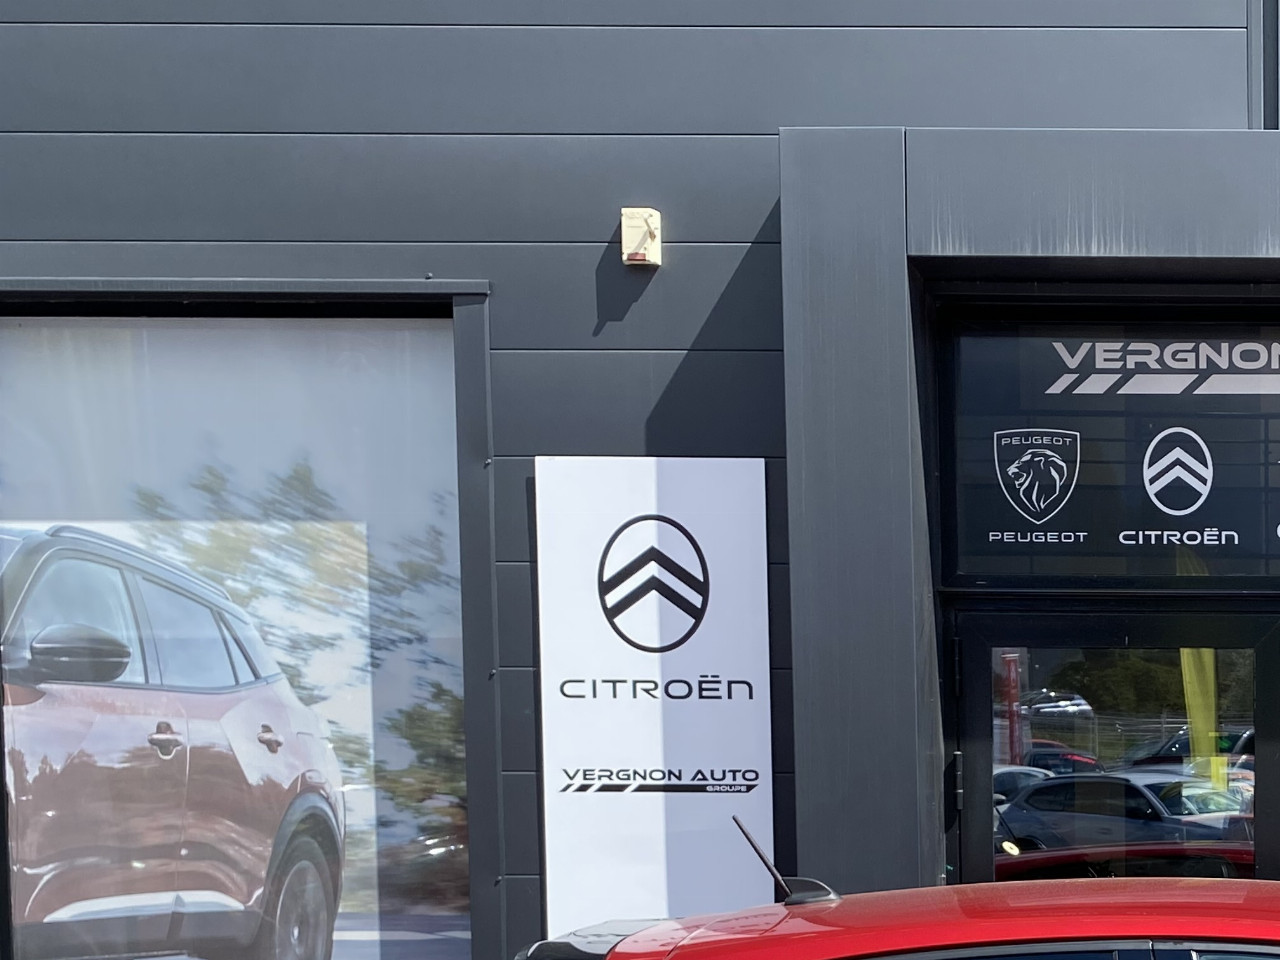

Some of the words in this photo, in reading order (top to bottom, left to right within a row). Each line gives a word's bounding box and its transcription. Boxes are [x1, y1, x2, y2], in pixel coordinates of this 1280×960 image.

[1001, 435, 1073, 446] PEUGEOT
[989, 531, 1088, 543] PEUGEOT
[562, 768, 683, 782] VERGNON
[690, 768, 760, 782] AUTO
